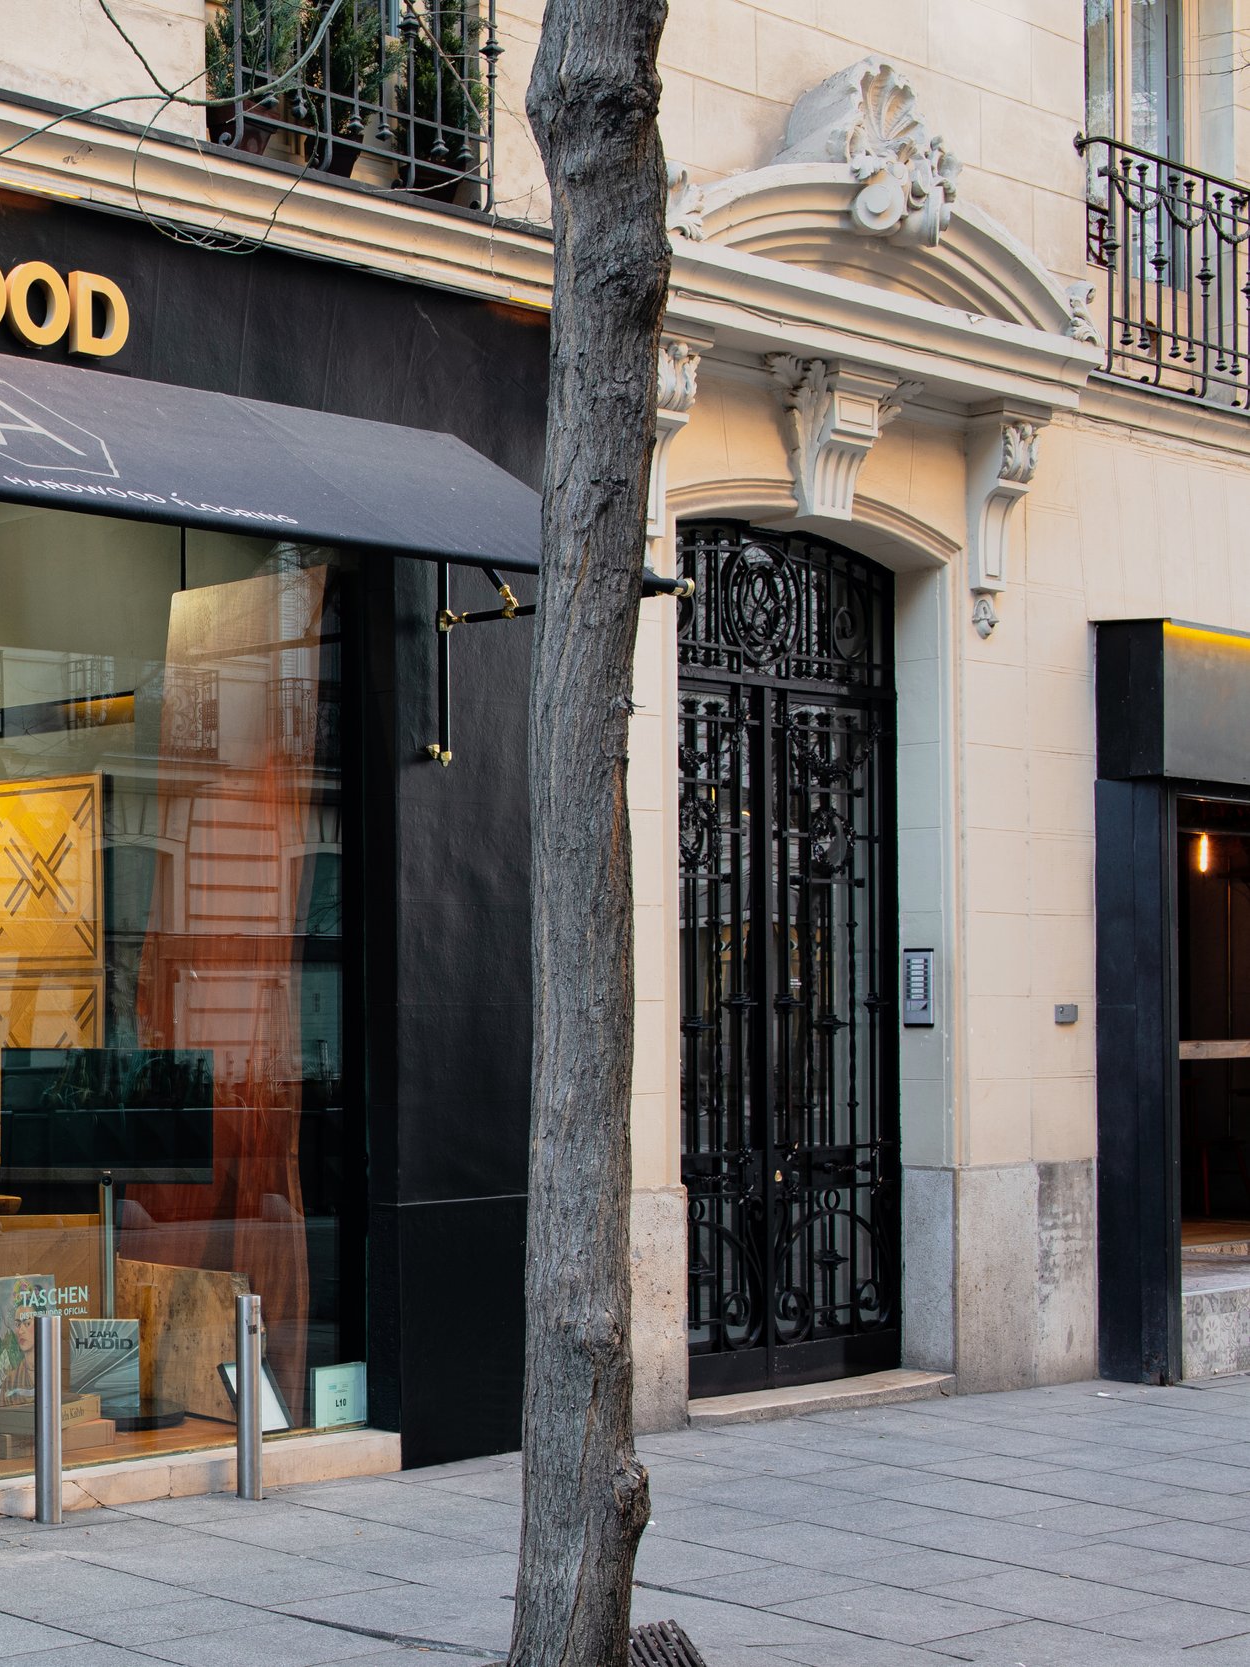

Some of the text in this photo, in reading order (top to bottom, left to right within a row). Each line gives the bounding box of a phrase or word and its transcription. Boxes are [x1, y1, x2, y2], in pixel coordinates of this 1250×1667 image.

[3, 475, 166, 504] HARDWOOD
[170, 497, 298, 524] FLOORING
[20, 1285, 89, 1308] TASCHEN
[64, 1306, 88, 1316] OFICIAL
[89, 1330, 119, 1338] ZAHA
[75, 1337, 134, 1350] HADID
[335, 1398, 347, 1407] L10
